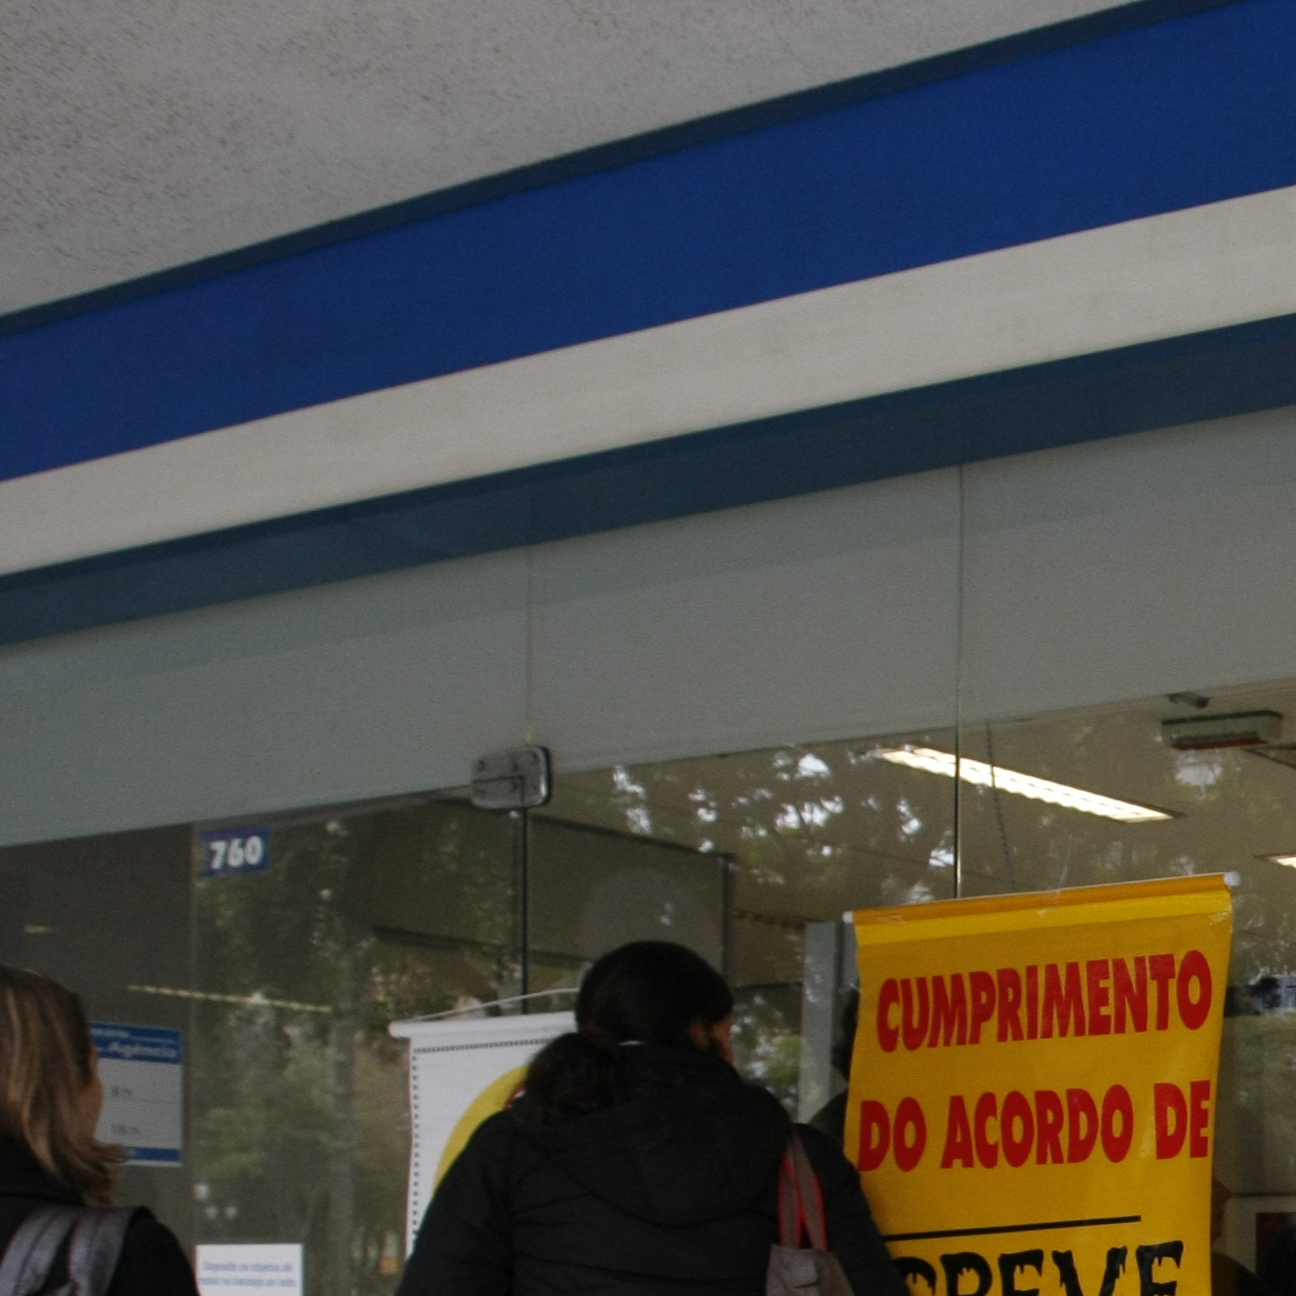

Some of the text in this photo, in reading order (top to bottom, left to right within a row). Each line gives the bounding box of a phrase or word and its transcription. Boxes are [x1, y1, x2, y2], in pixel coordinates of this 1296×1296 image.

[210, 836, 263, 870] 760
[876, 950, 1212, 1053] CUMPRIMENTO
[857, 1080, 1211, 1172] DO ACORDO DE
